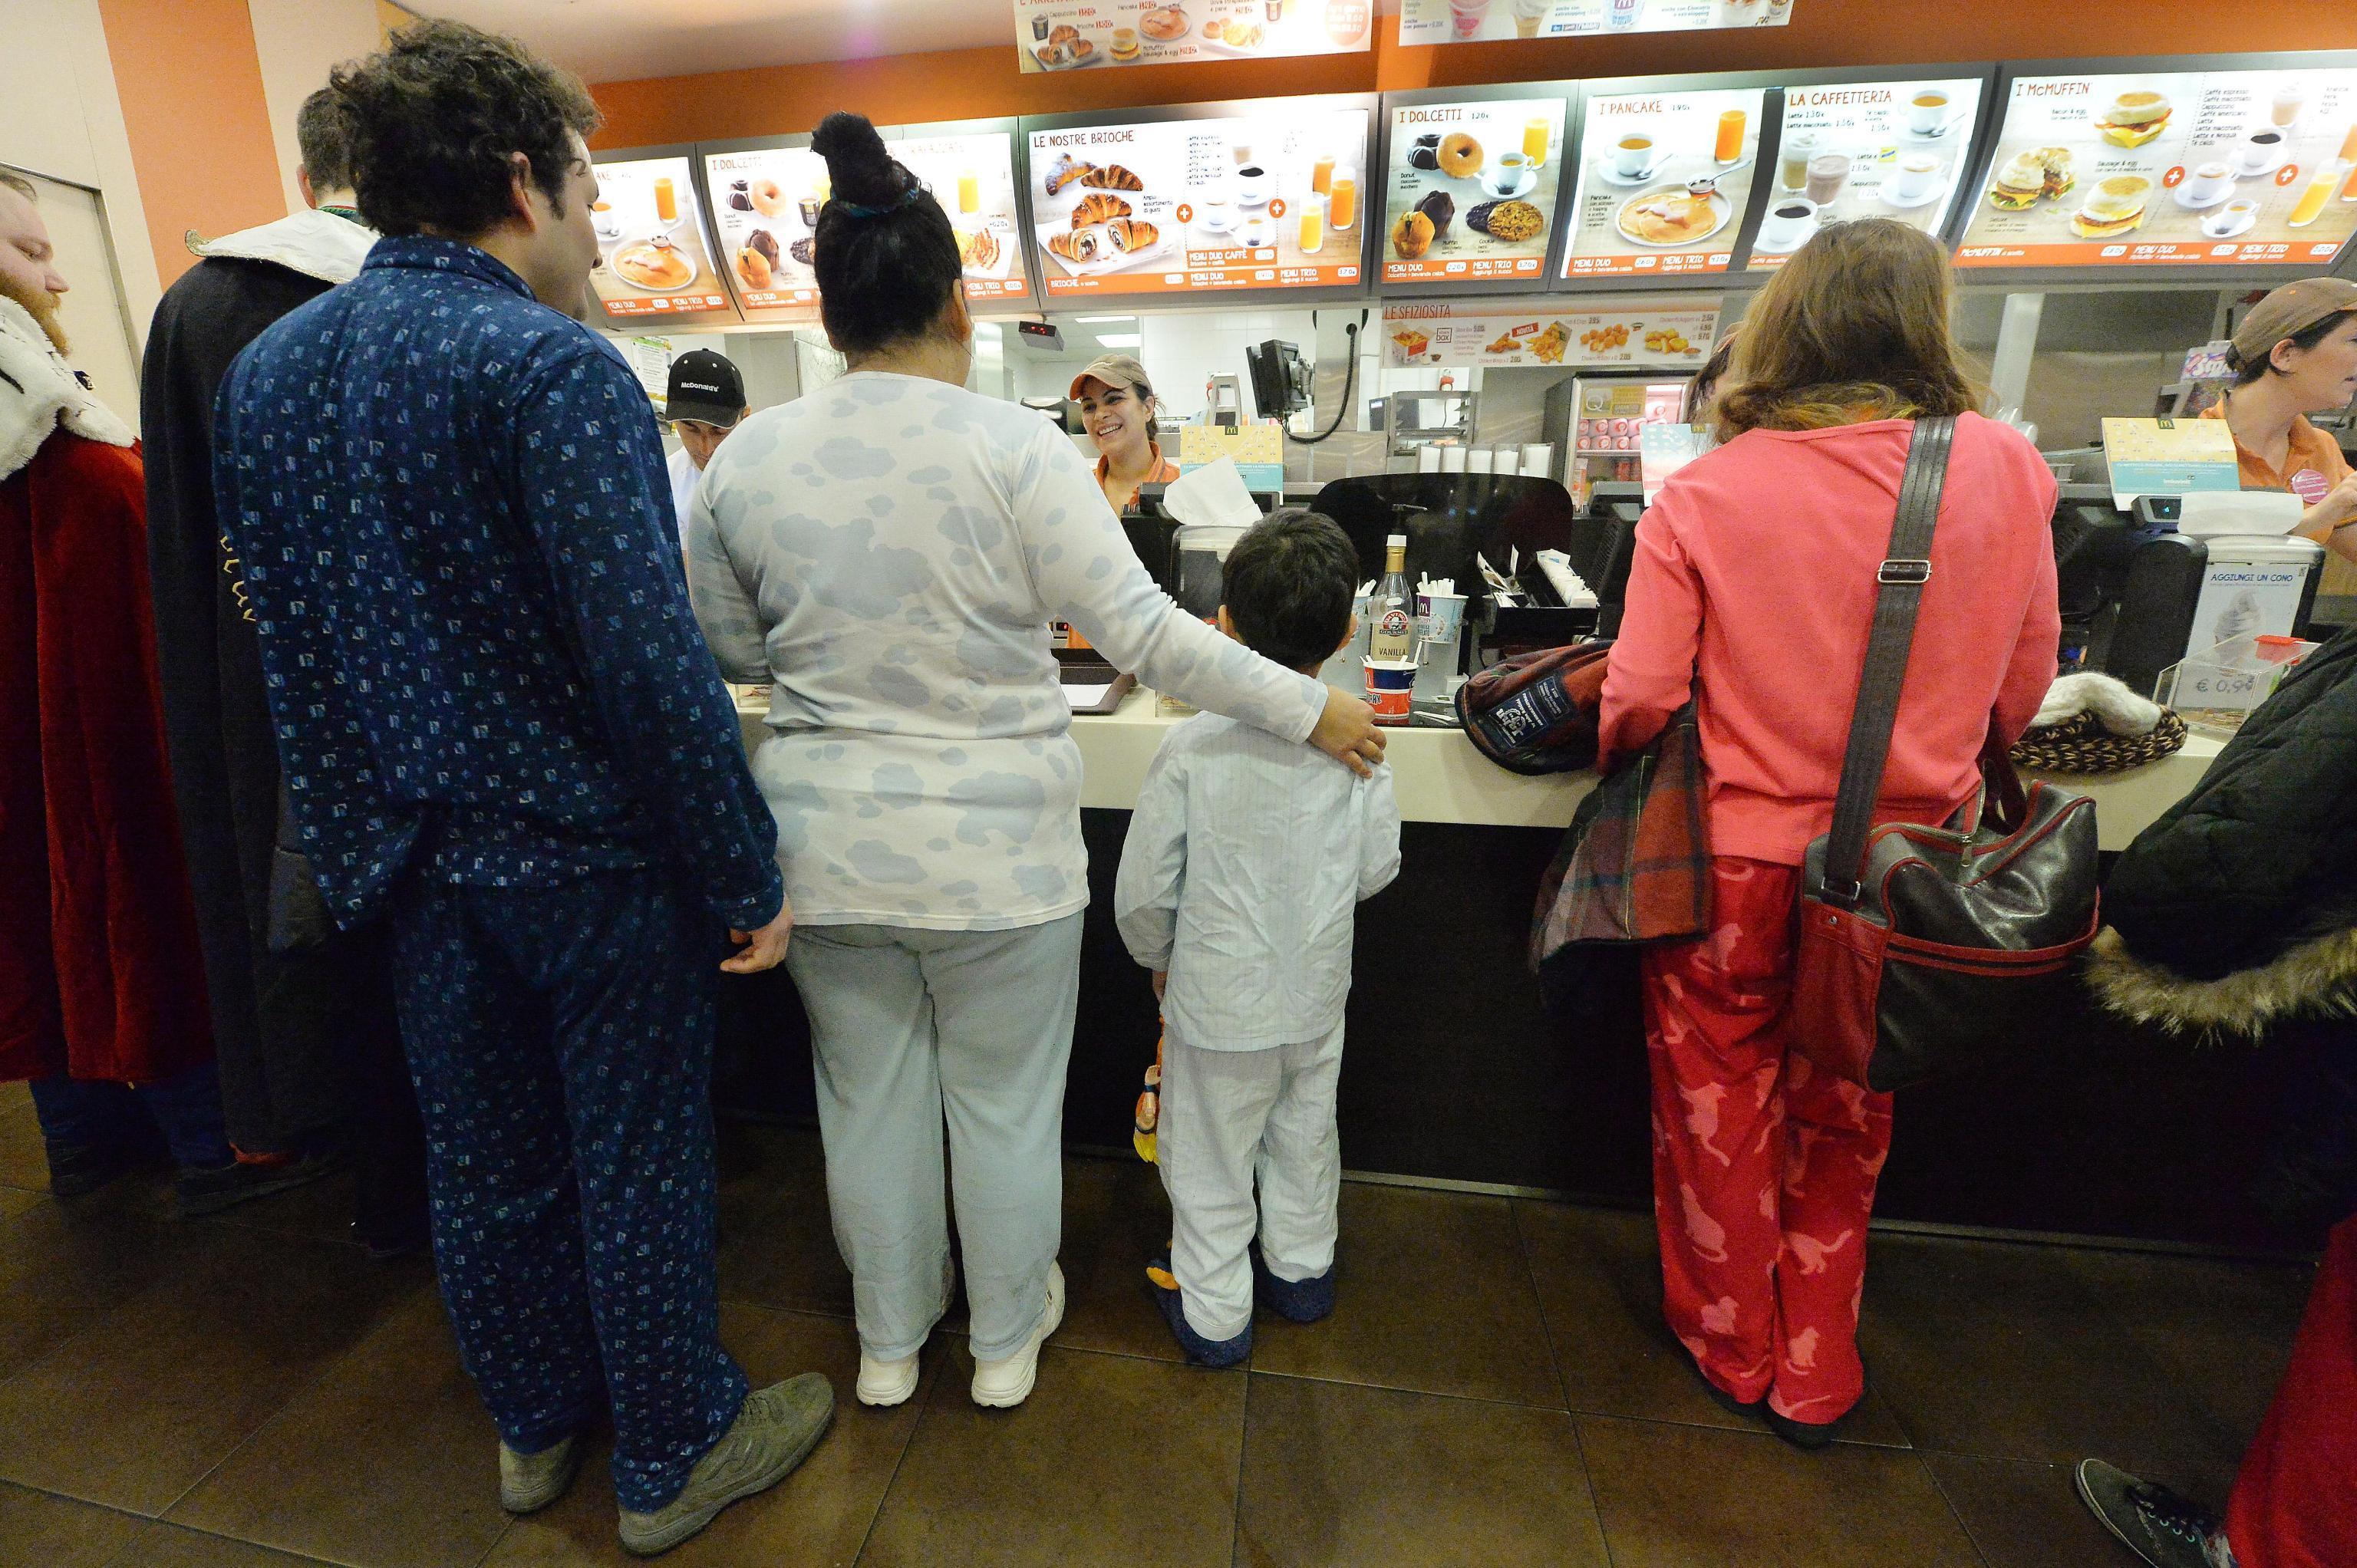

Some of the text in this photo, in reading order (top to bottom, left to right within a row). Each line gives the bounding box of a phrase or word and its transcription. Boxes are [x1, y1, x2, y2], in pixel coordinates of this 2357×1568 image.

[2016, 82, 2091, 97] I McMUFFIN
[1789, 90, 1892, 107] LA CAFFETTERIA
[1600, 100, 1663, 115] I PANCAKE
[1399, 112, 1406, 123] I
[1409, 108, 1462, 123] DOLCETTI
[1034, 130, 1134, 148] LE NOSTRE BRIOCHE
[2134, 245, 2177, 254] MENU DUO
[2242, 244, 2289, 253] MENU TRIO
[1189, 252, 1208, 262] MENU
[1208, 251, 1224, 260] DUO
[1663, 255, 1704, 265] MENU TRIO
[1473, 260, 1512, 269] MENU TRIO
[1573, 257, 1611, 267] MENU DUO
[1388, 264, 1407, 272] MENU
[1408, 263, 1423, 272] DUO
[1191, 272, 1209, 281] MENU
[1210, 272, 1225, 280] DUO
[1050, 278, 1079, 288] BRIOCHE
[1385, 306, 1396, 320] LE
[681, 382, 719, 392] McDonald's
[2210, 573, 2255, 581] AGGIUNGI
[1379, 647, 1406, 657] VANILLA
